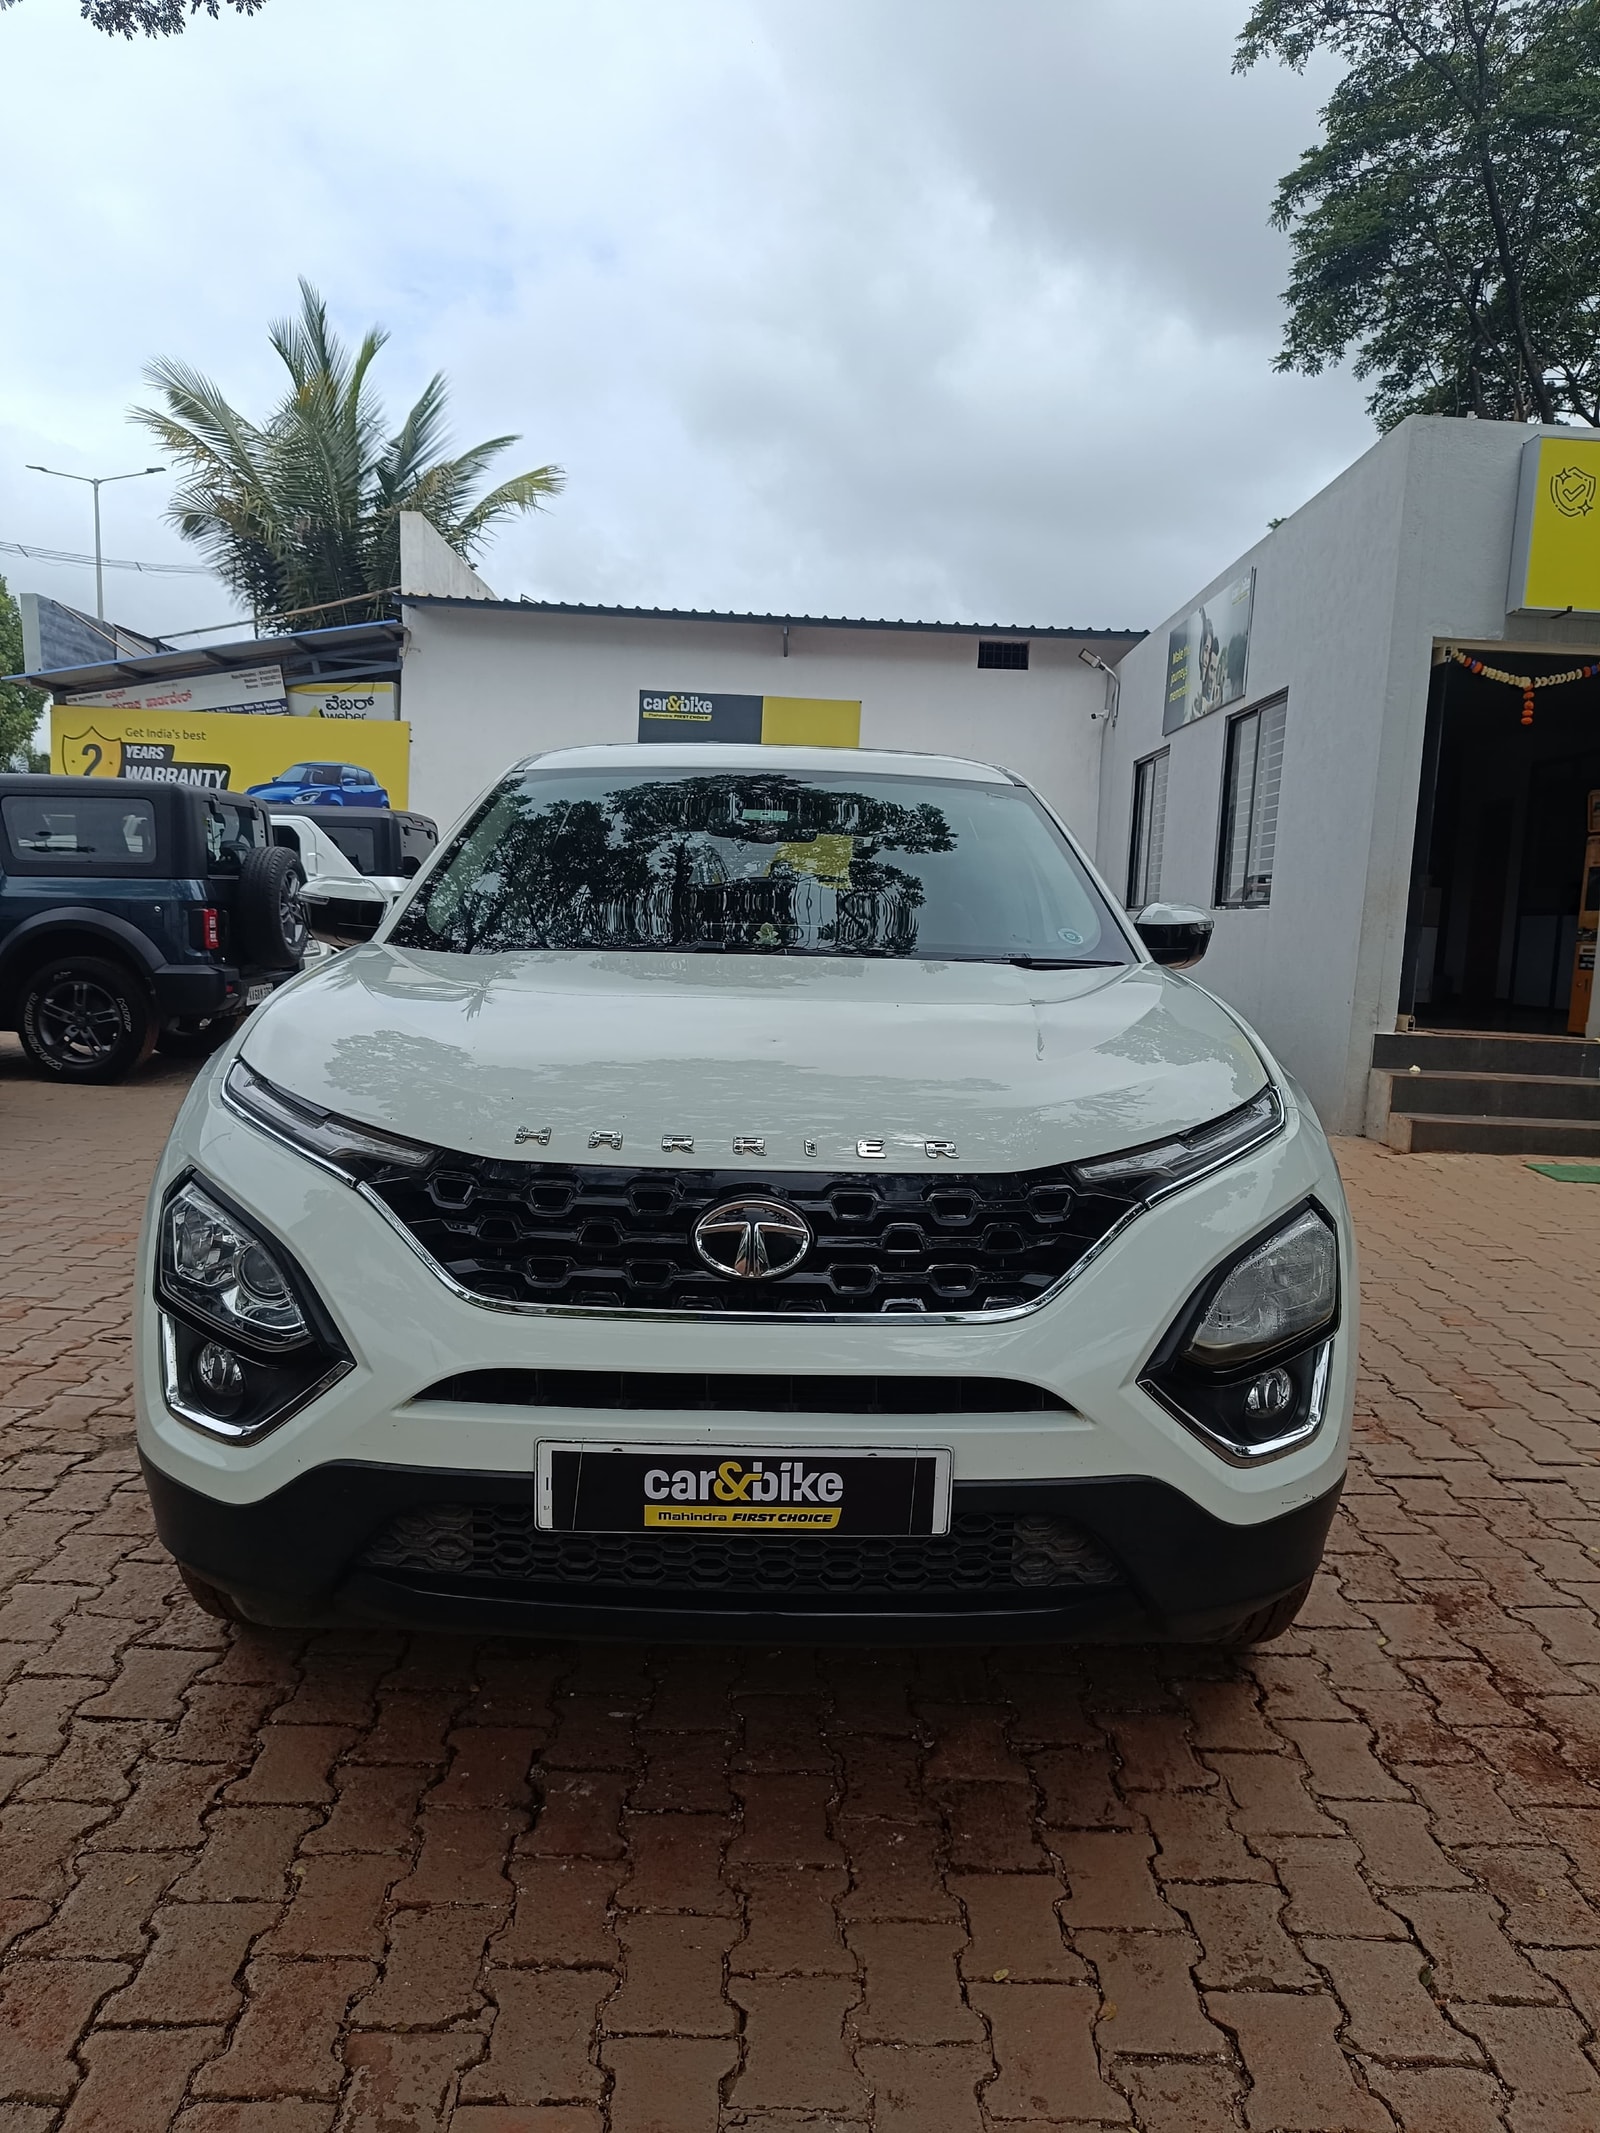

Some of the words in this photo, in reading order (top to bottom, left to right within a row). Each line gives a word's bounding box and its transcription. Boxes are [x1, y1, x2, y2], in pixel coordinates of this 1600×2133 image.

[325, 695, 374, 711] ವೆಬರ್
[643, 695, 713, 713] car&bike
[125, 727, 144, 738] Get
[146, 728, 181, 739] India's
[182, 730, 207, 741] best
[81, 743, 103, 776] 2
[126, 745, 165, 760] YEARS
[125, 765, 227, 790] WARRANTY
[514, 1125, 960, 1160] HARRIER
[643, 1460, 844, 1502] car&bike
[658, 1511, 727, 1522] Mahindra
[731, 1513, 777, 1522] FIRST
[777, 1513, 833, 1523] CHOICE
